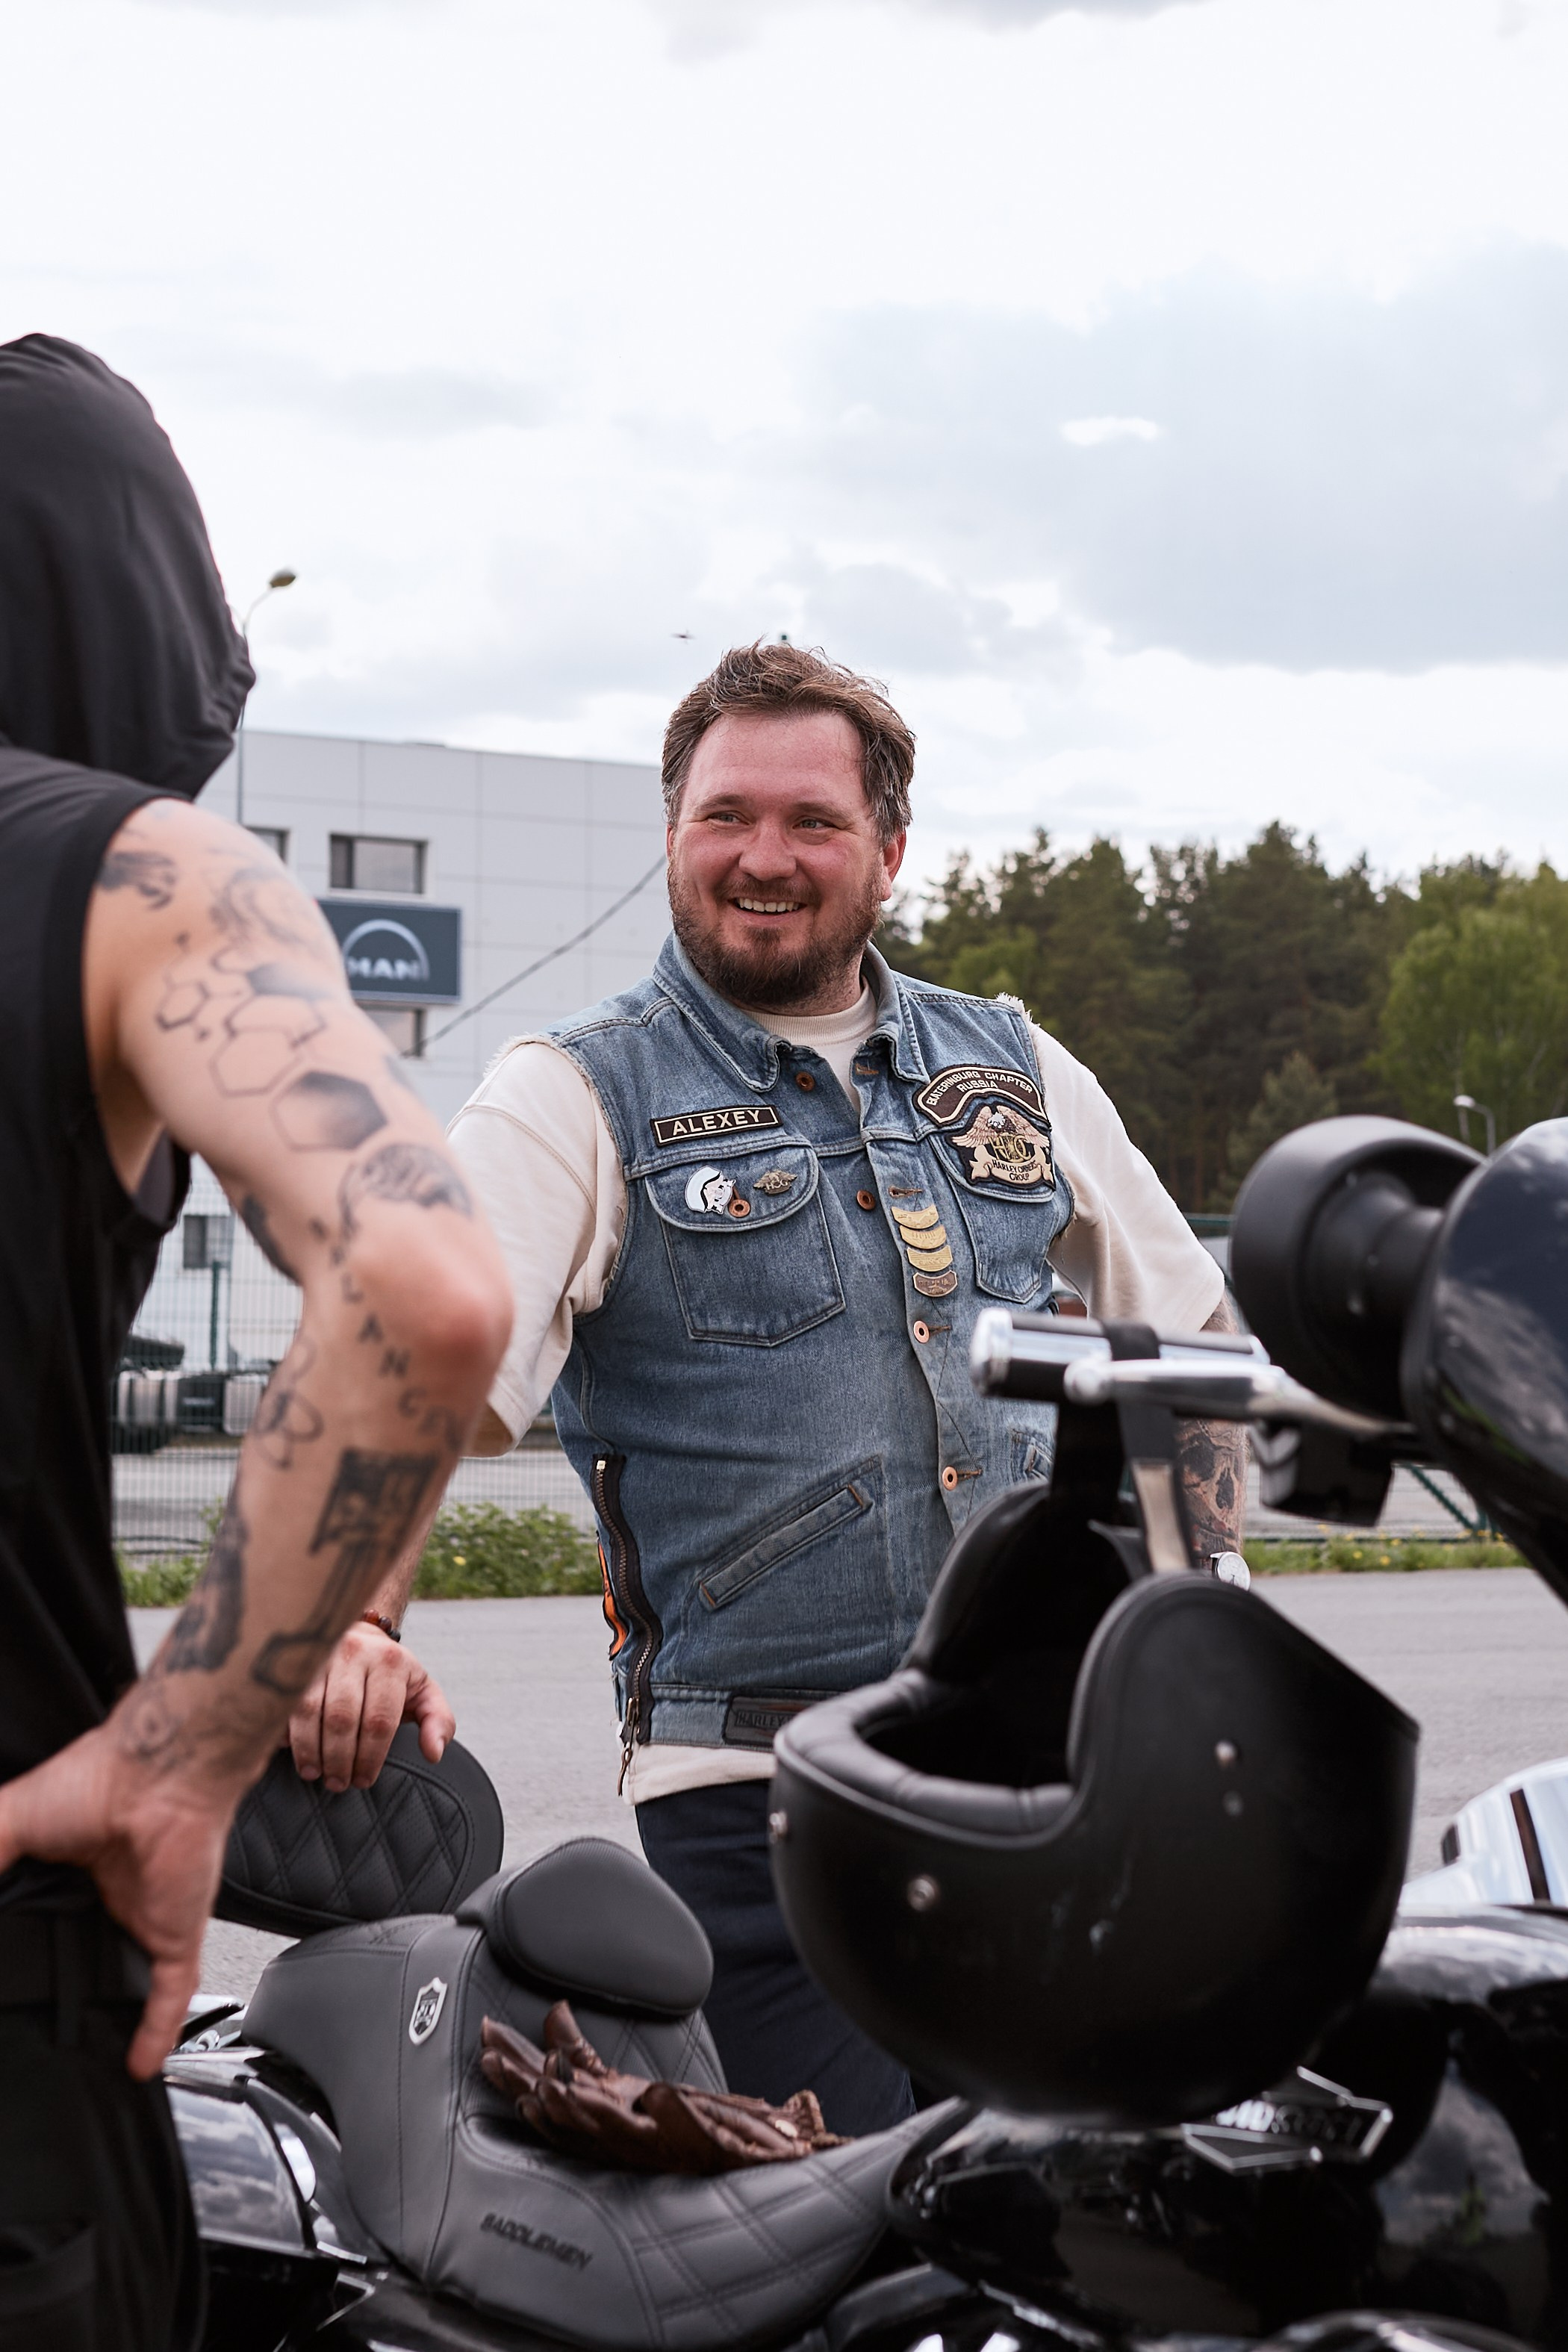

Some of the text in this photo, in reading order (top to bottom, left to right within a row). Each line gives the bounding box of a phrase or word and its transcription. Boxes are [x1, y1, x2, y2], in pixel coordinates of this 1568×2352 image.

[345, 956, 421, 981] MAN
[956, 1080, 998, 1092] RUSSIA
[985, 1072, 1033, 1093] CHAPTER
[672, 1110, 761, 1136] ALEXEY
[992, 1160, 1017, 1173] HARLEY
